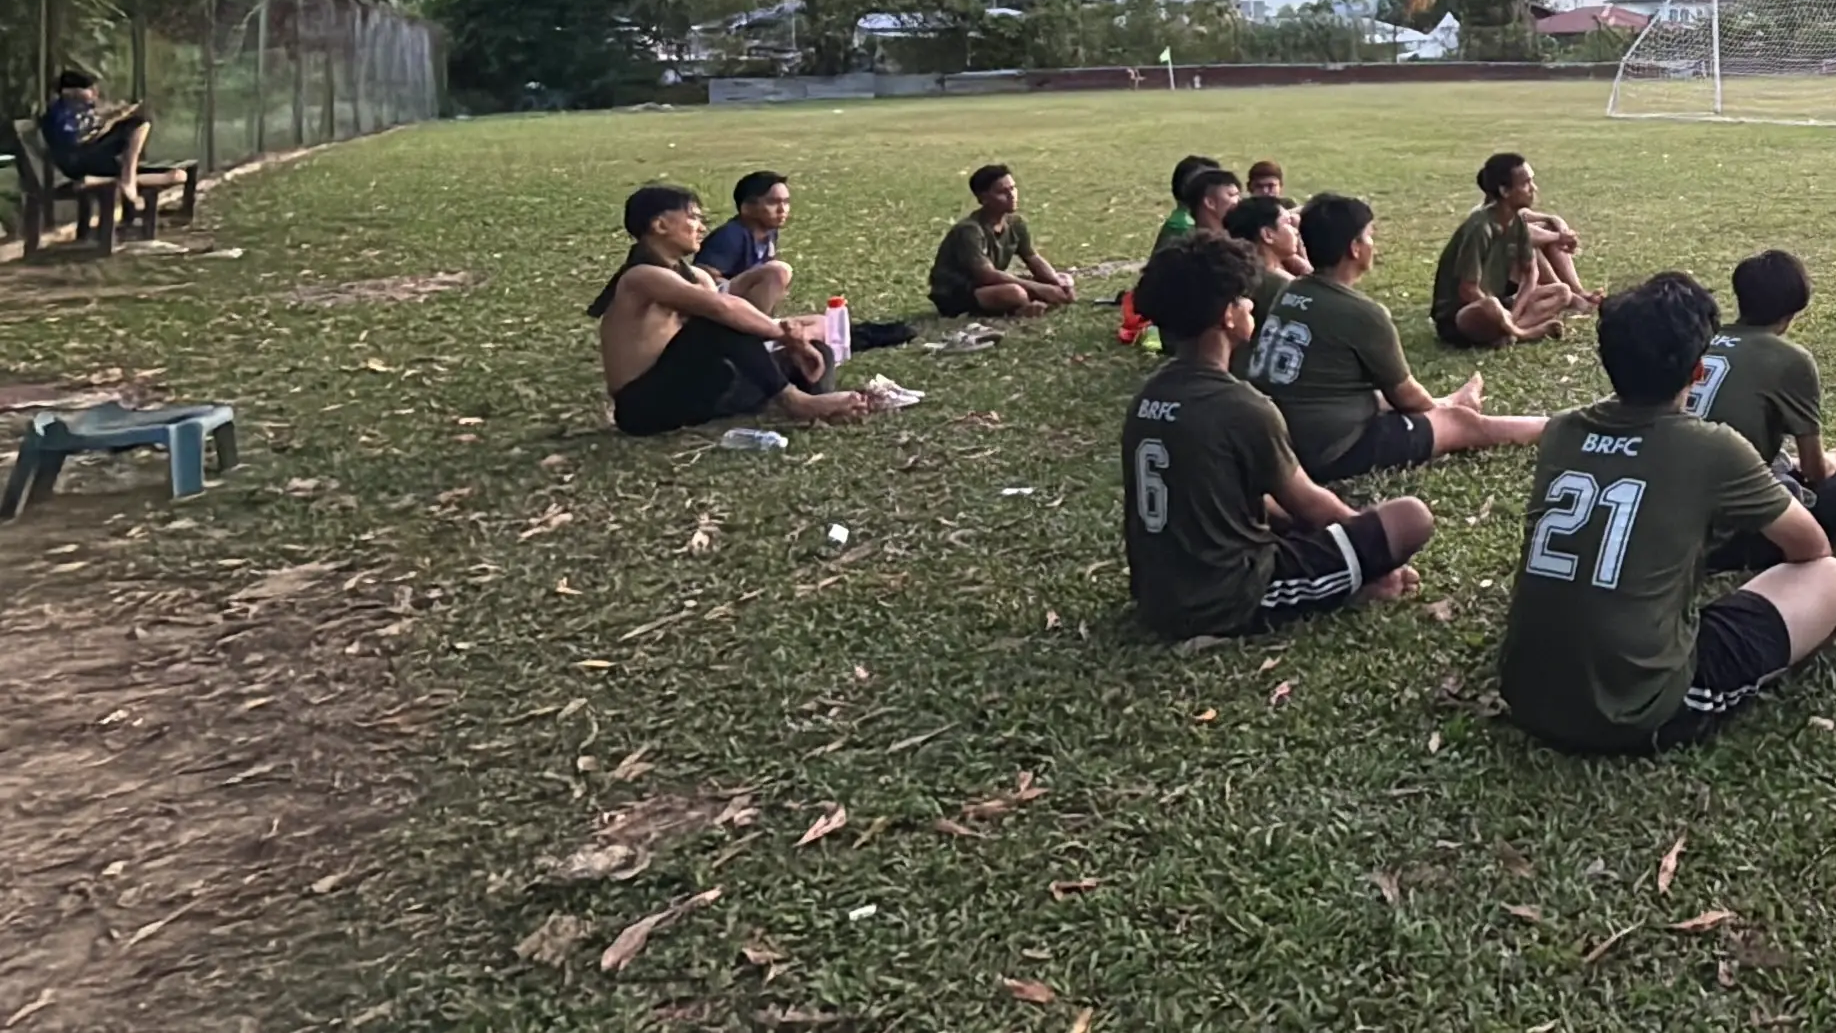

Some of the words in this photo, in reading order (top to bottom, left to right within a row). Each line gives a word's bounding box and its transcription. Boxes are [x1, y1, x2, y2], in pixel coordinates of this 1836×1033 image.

[1137, 399, 1181, 421] BRFC
[1581, 433, 1643, 456] BRFC
[1135, 438, 1169, 533] 6
[1526, 470, 1647, 589] 21
